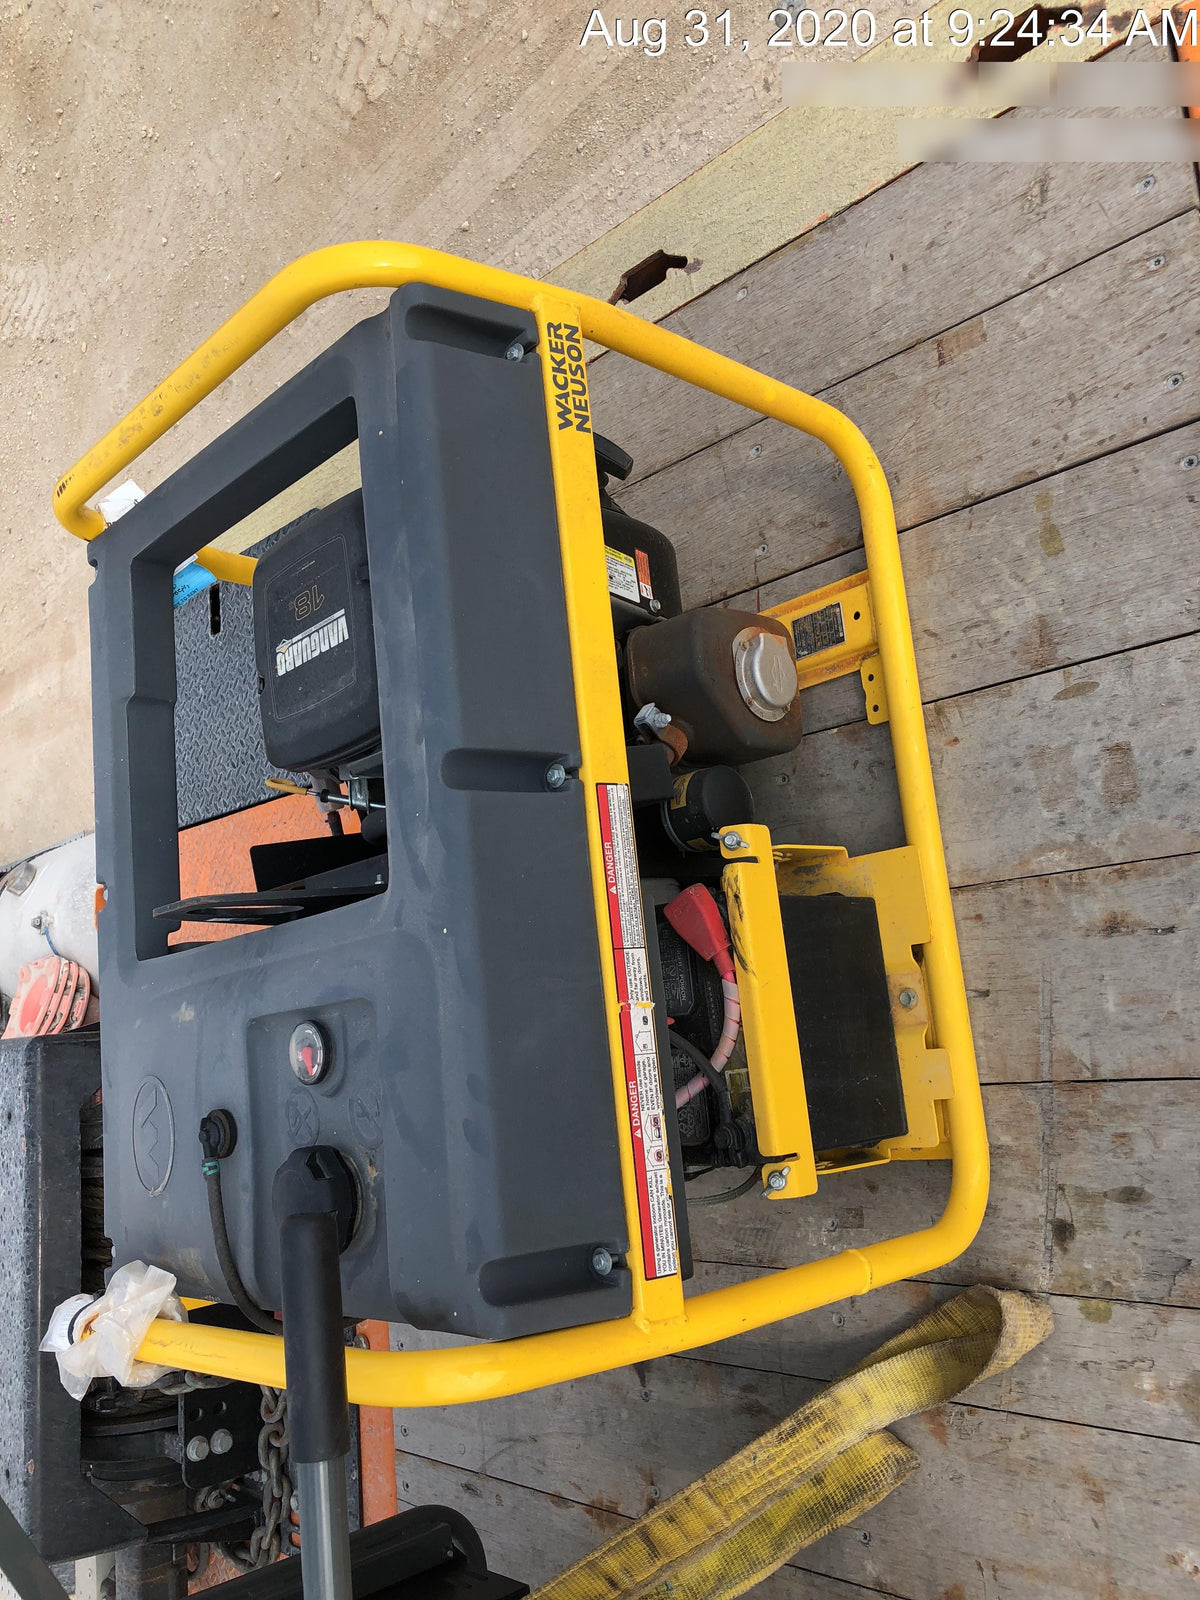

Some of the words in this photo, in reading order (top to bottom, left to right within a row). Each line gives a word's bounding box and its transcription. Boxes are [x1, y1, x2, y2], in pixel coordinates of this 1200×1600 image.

[546, 322, 574, 431] WACKER
[564, 324, 592, 434] NEUSON
[294, 585, 325, 621] 18
[276, 615, 349, 677] VANGUARD
[605, 842, 615, 883] DANGER
[679, 974, 687, 1001] POISON
[630, 1080, 640, 1126] DANGER
